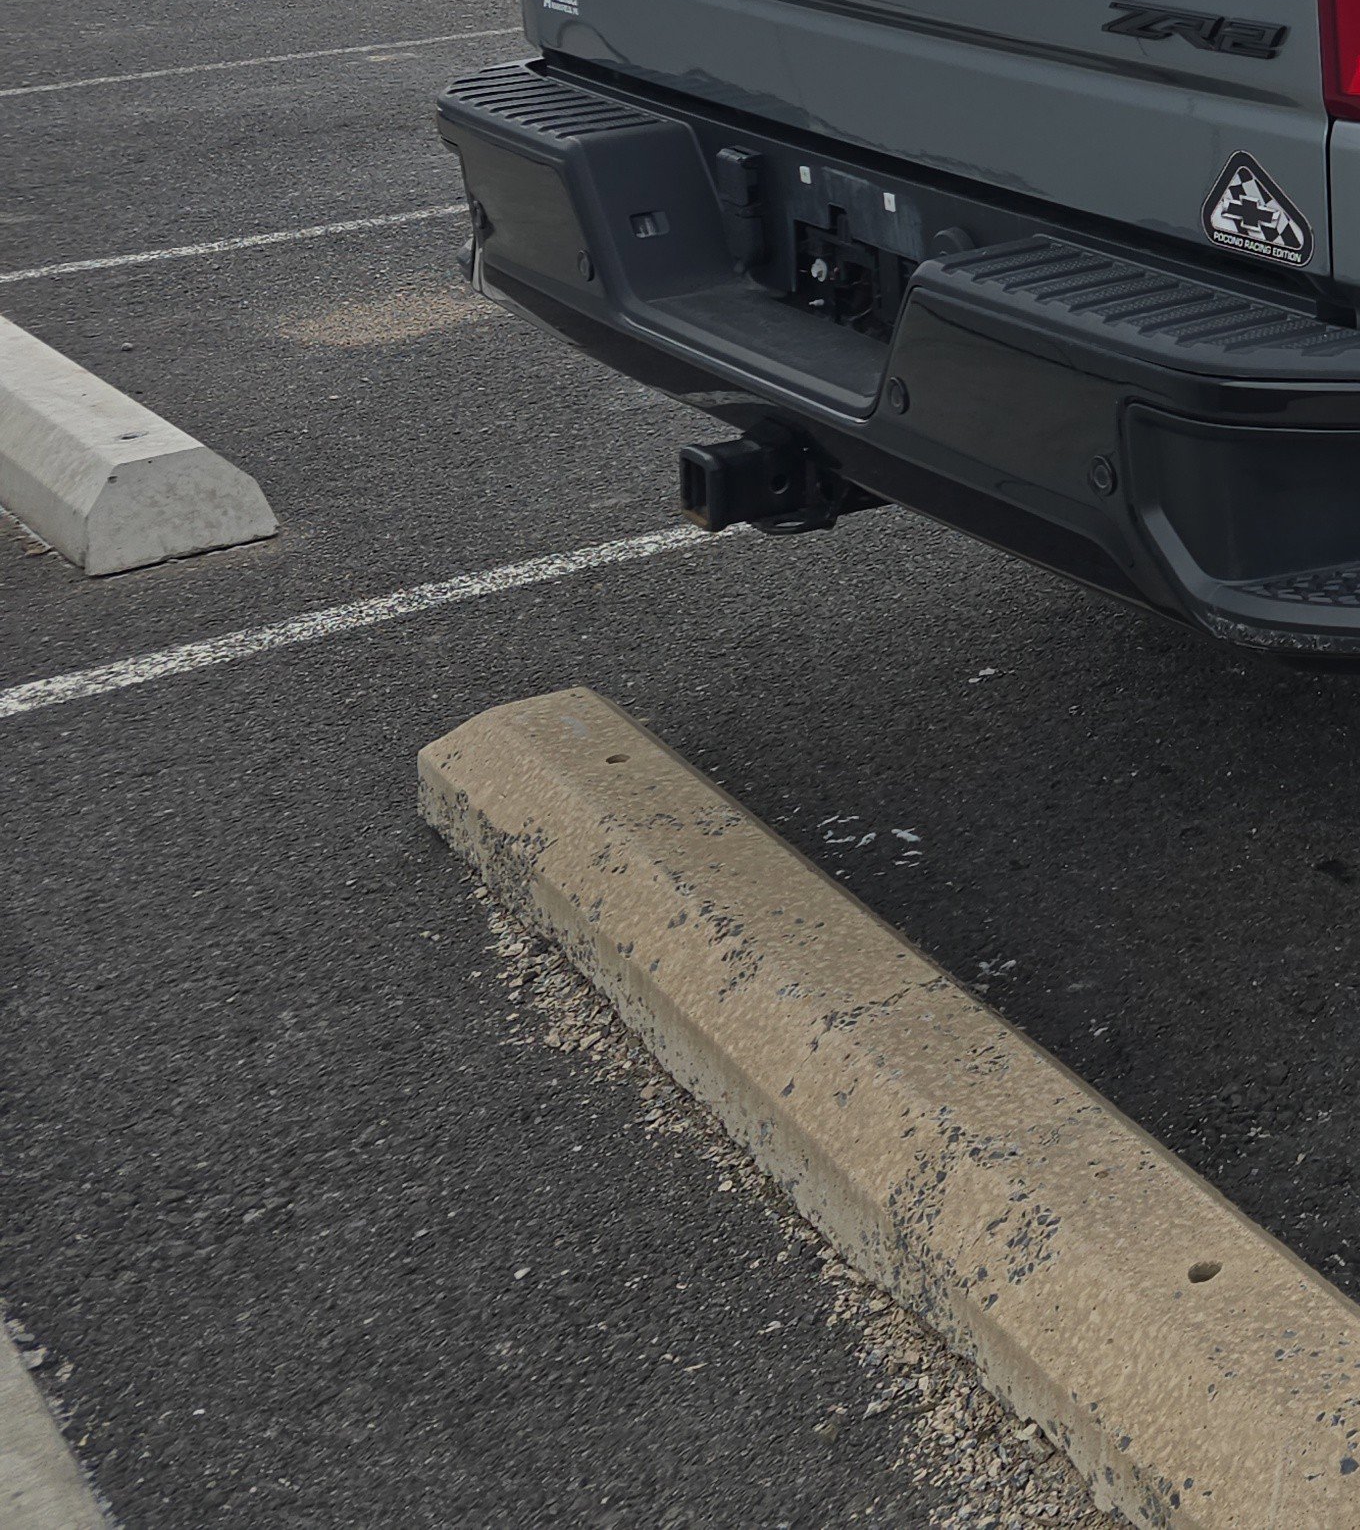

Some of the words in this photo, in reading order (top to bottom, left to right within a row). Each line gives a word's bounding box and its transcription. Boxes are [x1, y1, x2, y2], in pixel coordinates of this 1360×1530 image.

[1101, 0, 1288, 60] ZR2
[1213, 231, 1243, 246] POCONO
[1244, 237, 1272, 255] RACING
[1272, 248, 1302, 263] EDITION
